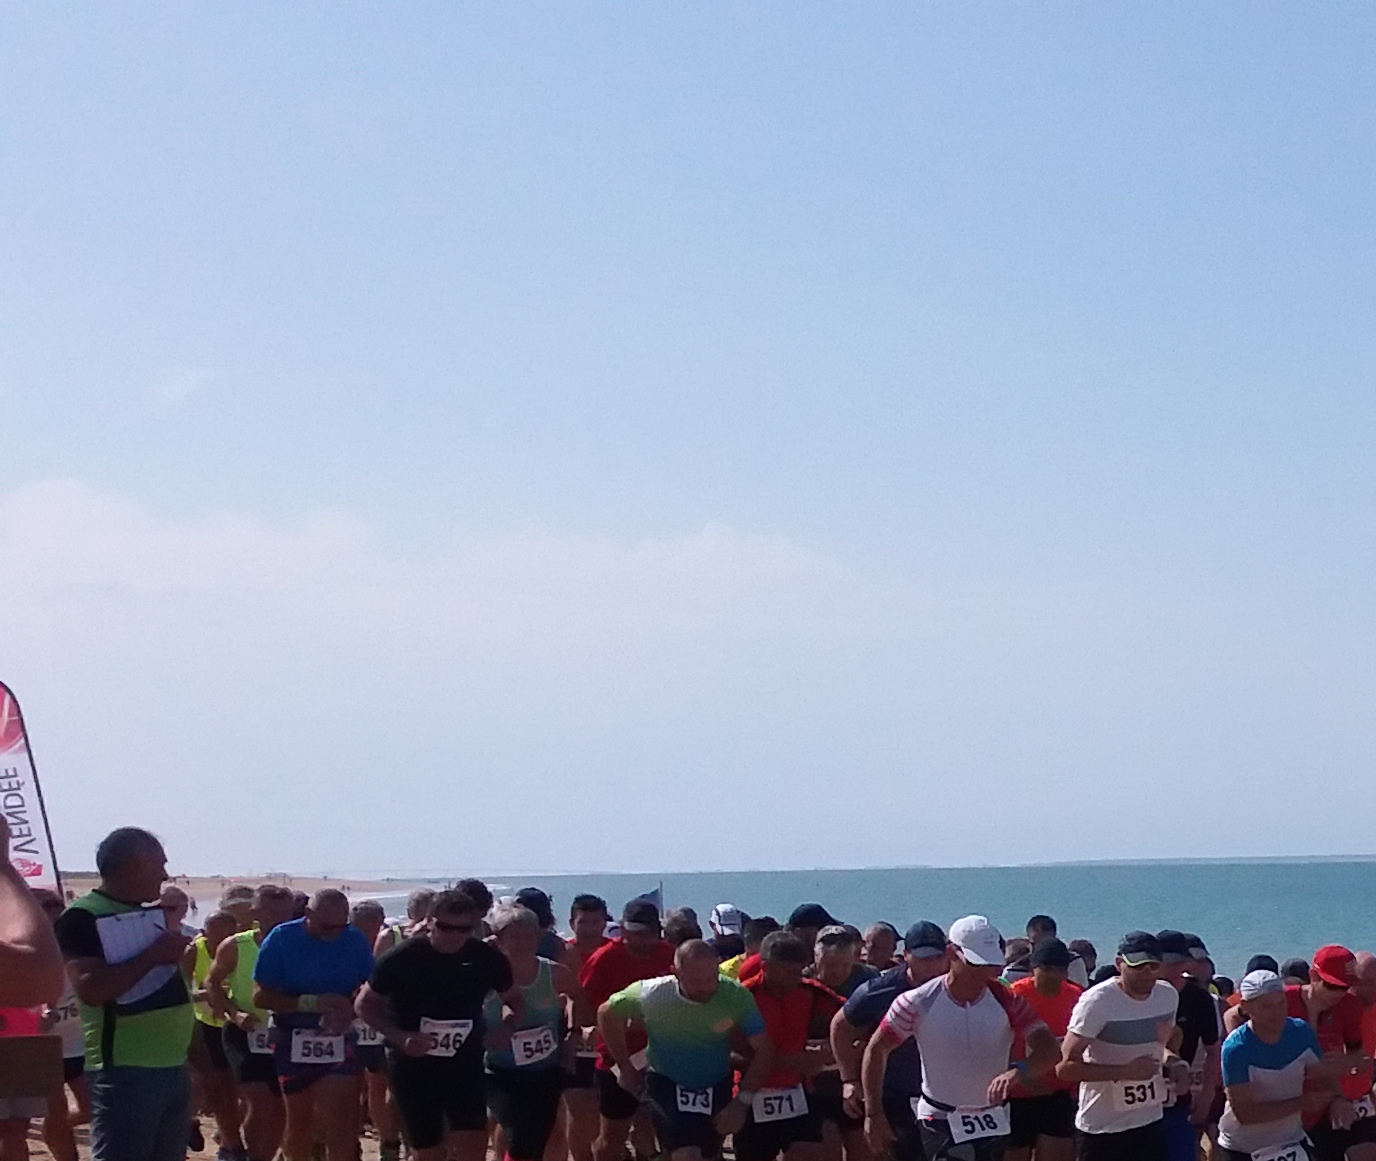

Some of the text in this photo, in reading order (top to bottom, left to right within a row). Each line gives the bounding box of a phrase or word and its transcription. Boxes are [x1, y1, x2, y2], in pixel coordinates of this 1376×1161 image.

[301, 1041, 334, 1058] 564
[523, 1034, 552, 1058] 545
[680, 1091, 710, 1108] 573
[1124, 1082, 1155, 1105] 531
[763, 1095, 794, 1115] 571
[961, 1113, 997, 1135] 518
